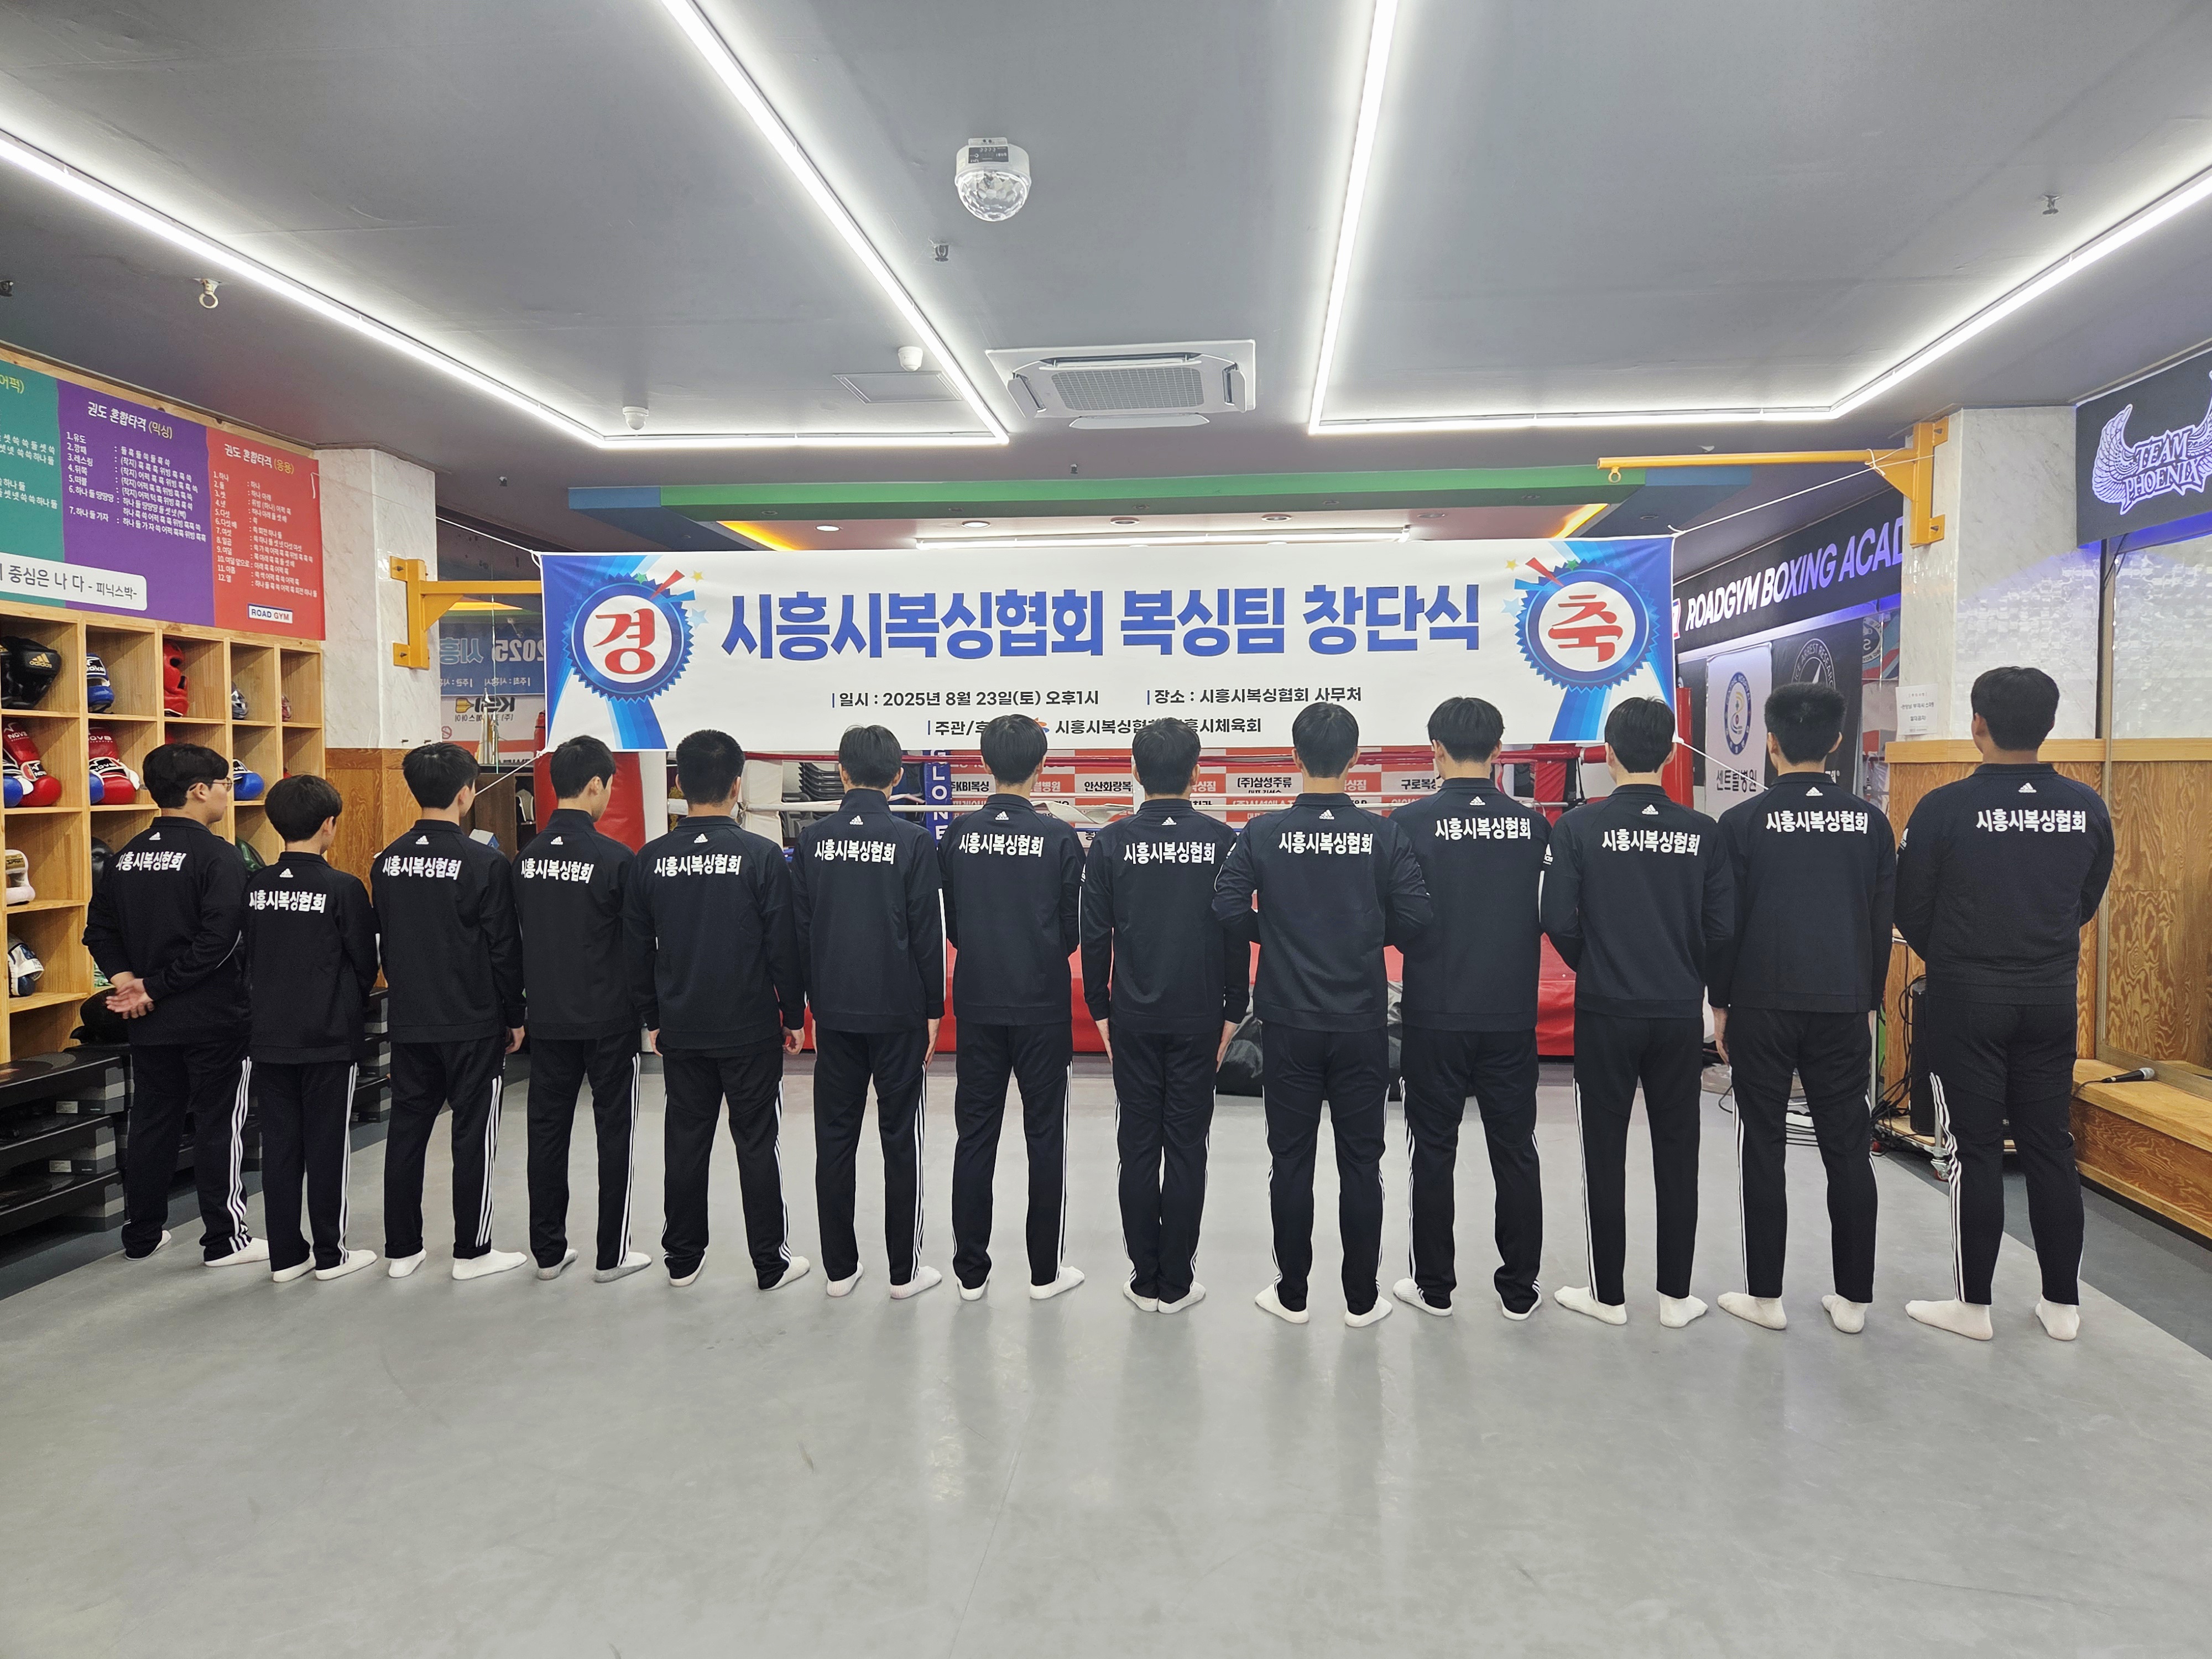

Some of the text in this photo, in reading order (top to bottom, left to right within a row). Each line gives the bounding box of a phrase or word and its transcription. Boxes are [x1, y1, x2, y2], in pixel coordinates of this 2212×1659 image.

[88, 402, 107, 418] 권도
[110, 409, 146, 431] 혼합타격
[30, 441, 38, 451] 둘
[67, 432, 86, 444] 1.유도
[68, 453, 92, 466] 3.레스링
[225, 444, 241, 457] 권도
[2136, 431, 2188, 474] TEAM
[2122, 457, 2202, 503] PHOENIX
[69, 486, 87, 497] 6.하나
[123, 498, 134, 507] 하나
[70, 507, 88, 518] 7.하나
[123, 508, 134, 517] 하나
[123, 518, 134, 527] 하나
[8, 565, 49, 587] 중심은
[54, 572, 67, 590] 나
[72, 575, 85, 592] 다
[1685, 517, 1903, 631] ROADGYM BOXING ACAD
[252, 609, 289, 620] ROAD GYM
[722, 585, 1478, 660] 시흥시복싱협회 복싱팀 창단식
[1548, 594, 1623, 662] 축
[593, 608, 655, 674] 경
[840, 693, 868, 706] 일시
[883, 692, 940, 706] 2025년
[946, 692, 970, 705] 8월
[977, 691, 1040, 705] 23일(토)
[1046, 691, 1098, 705] 오후1시
[1155, 690, 1185, 703] 장소
[1200, 688, 1308, 703] 시흥시복싱협회
[1315, 687, 1361, 703] 사무처
[1055, 718, 1156, 736] 시흥시복싱협
[1084, 781, 1133, 792] 안산화랑복
[1237, 777, 1292, 788] (주)삼성주류
[1435, 817, 1531, 840] 시흥시복싱협회
[1766, 811, 1867, 834] 시흥시복싱협회
[1976, 809, 2085, 833] 시흥시복싱협회
[815, 839, 896, 864] 시흥시복싱협회
[959, 833, 1044, 857] 시흥시복싱협회
[1124, 842, 1215, 864] 시흥시복싱협회
[1279, 832, 1373, 854] 시흥시복싱협회
[1602, 829, 1700, 855] 시흥시복싱협회
[382, 855, 461, 880] 시흥시복싱협회
[654, 854, 742, 877] 시흥시복싱협회
